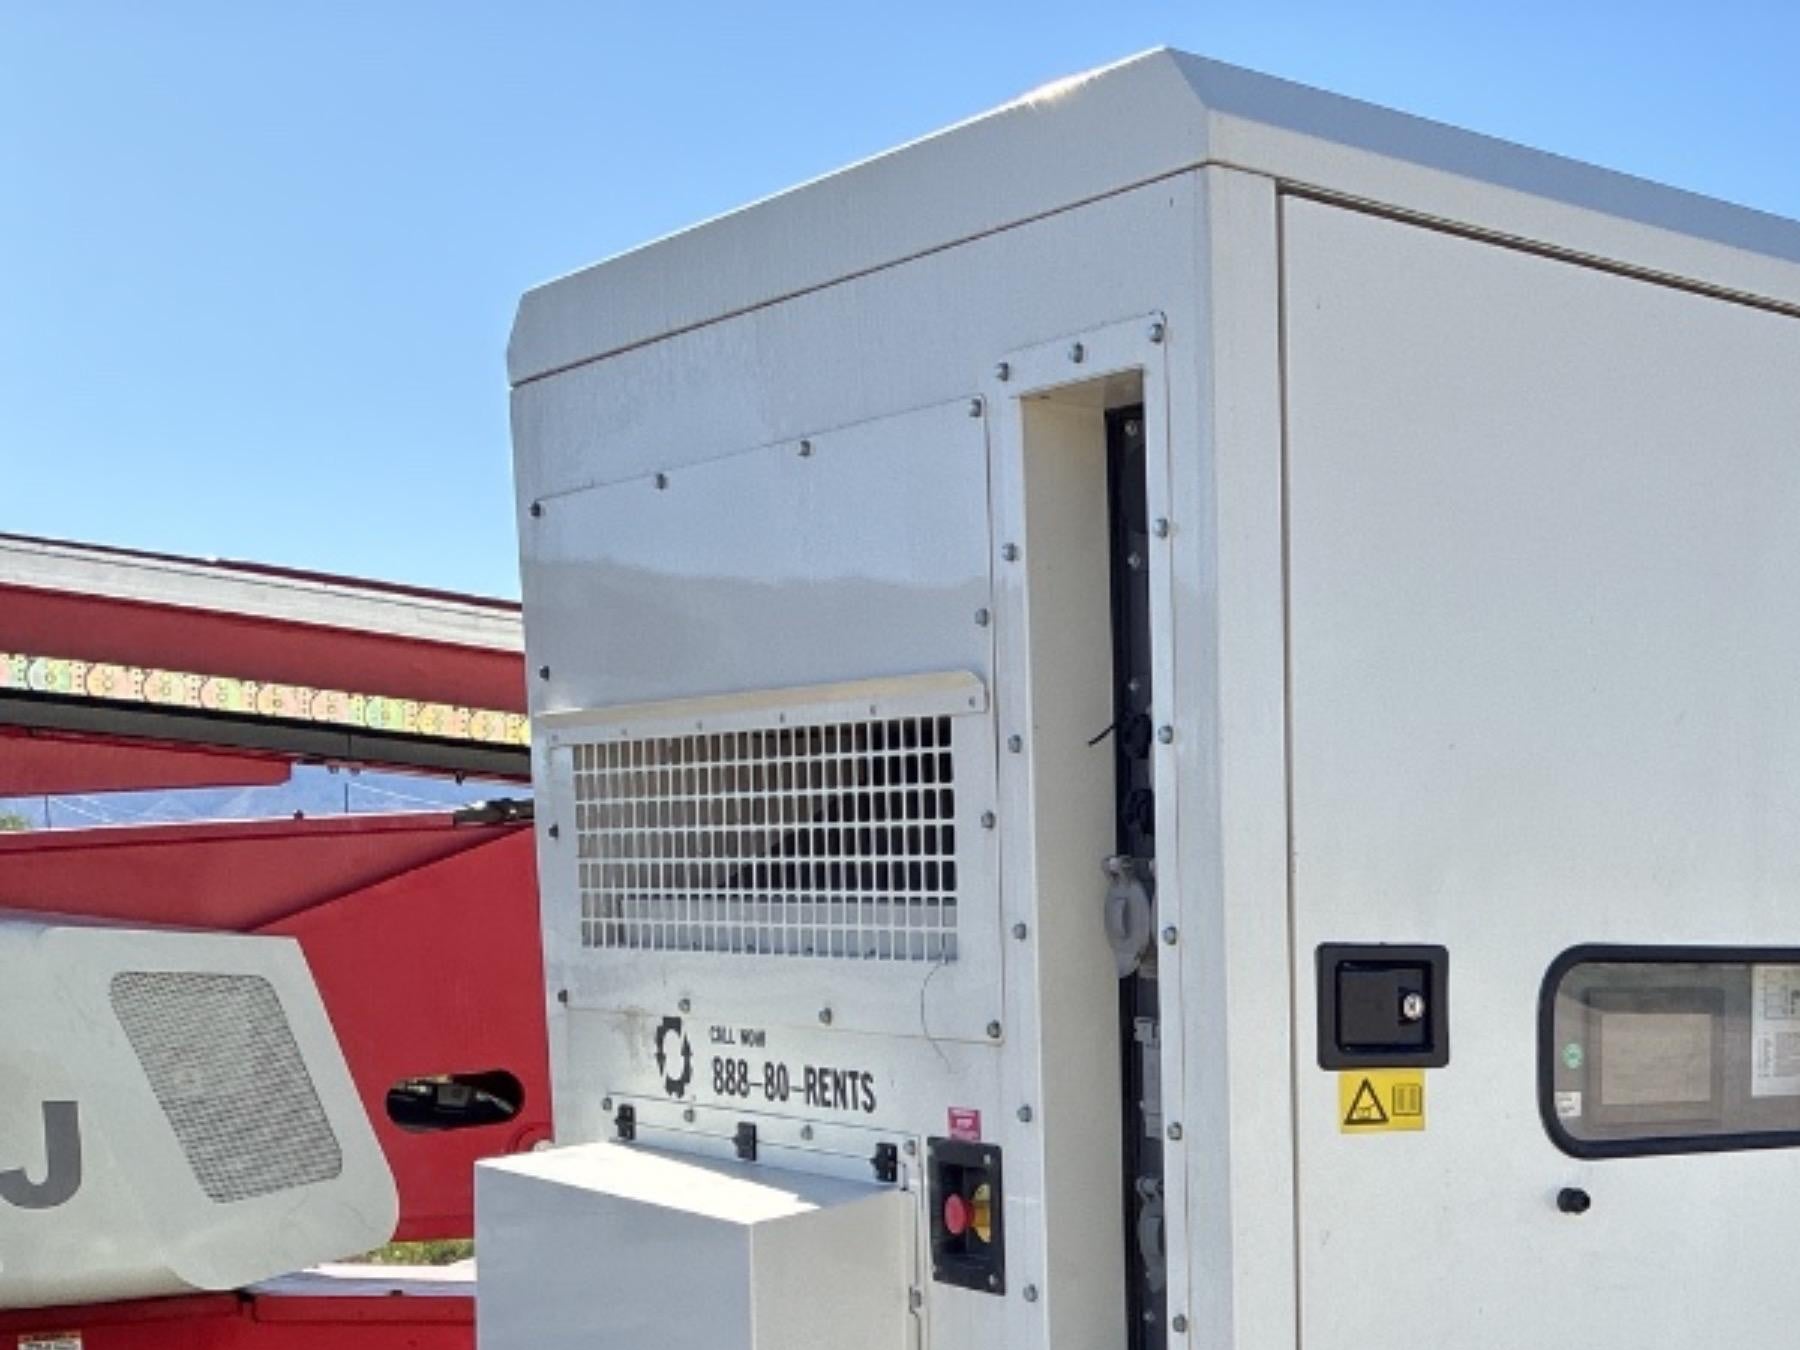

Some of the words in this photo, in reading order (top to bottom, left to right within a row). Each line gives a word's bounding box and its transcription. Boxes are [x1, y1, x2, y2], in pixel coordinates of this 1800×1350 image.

[710, 1024, 736, 1045] CALL
[739, 1027, 766, 1048] NOW
[712, 1055, 877, 1113] 888-80-RENTS
